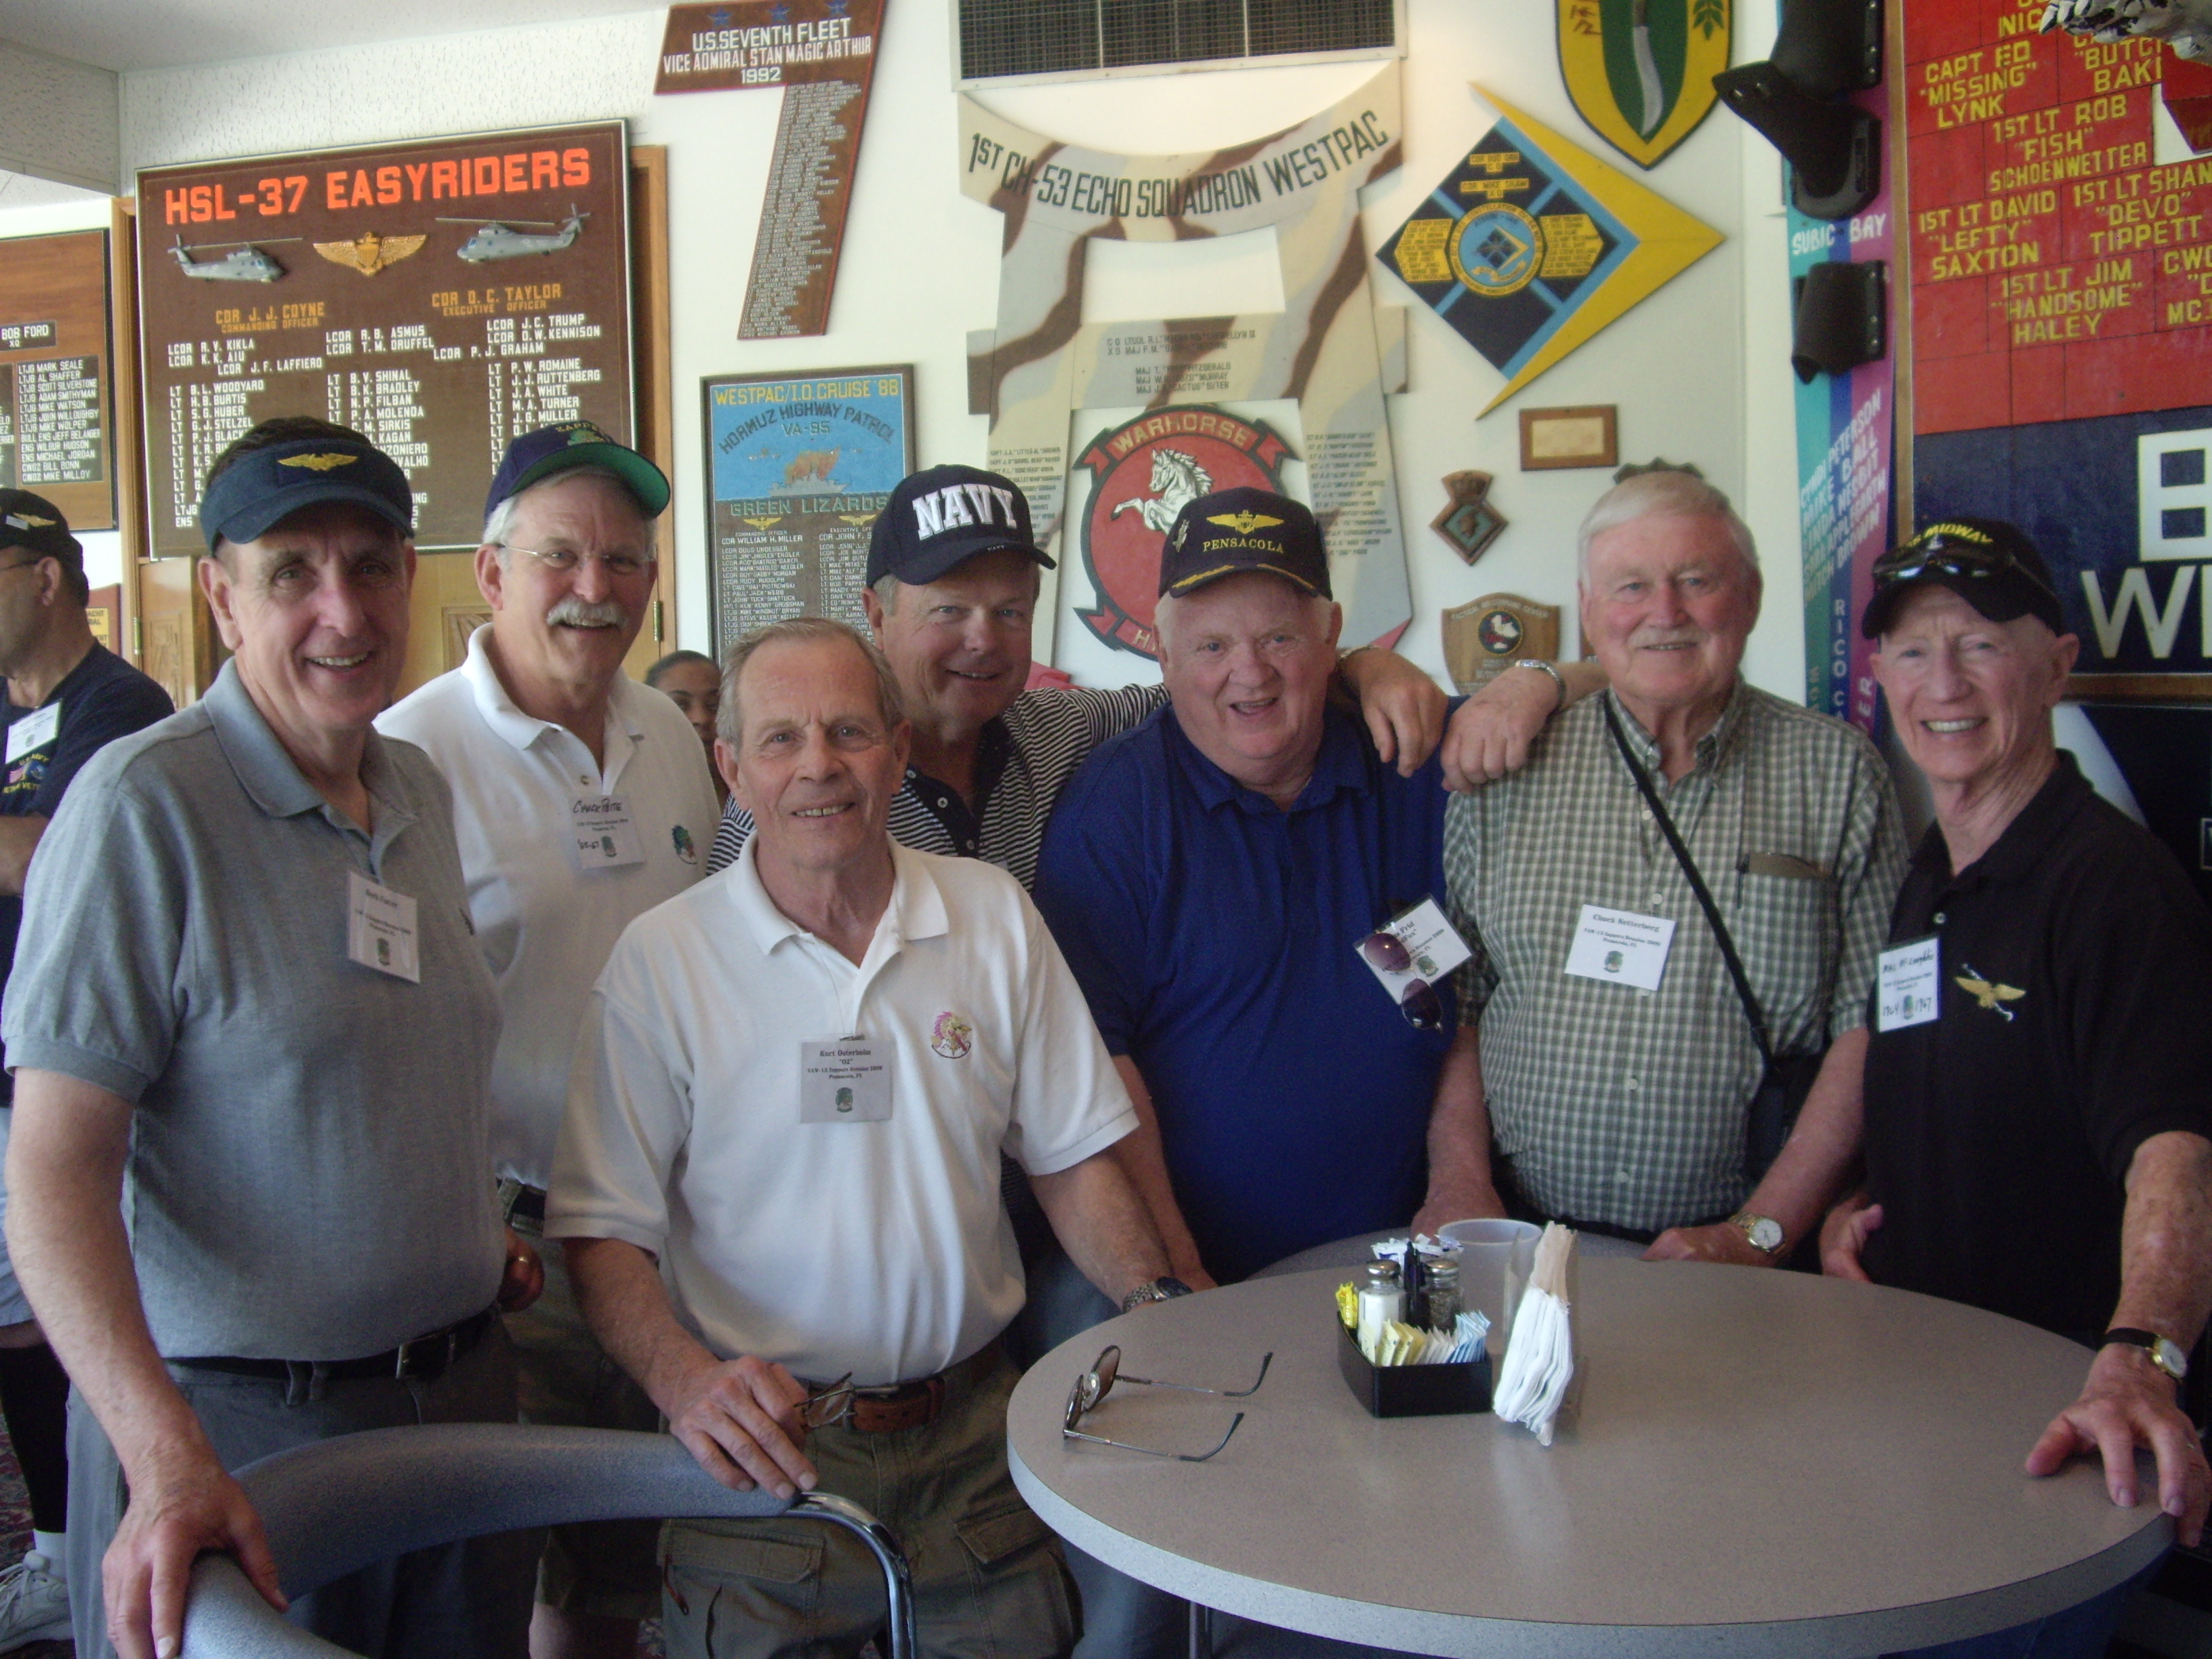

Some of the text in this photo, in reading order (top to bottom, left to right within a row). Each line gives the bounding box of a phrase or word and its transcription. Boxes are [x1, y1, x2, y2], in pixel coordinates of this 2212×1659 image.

[797, 17, 852, 42] FLEET
[663, 54, 691, 74] VICE
[693, 48, 747, 70] ADMIRAL
[750, 45, 782, 66] STAN
[825, 35, 872, 59] ARTHUR
[1925, 39, 2031, 84] CAPT ED
[741, 66, 781, 84] 1992
[1920, 62, 2036, 106] "MISSING"
[1938, 94, 2005, 129] LYNK
[1992, 94, 2127, 143] 1ST LT ROB
[2015, 127, 2094, 162] "FISH"
[968, 108, 1390, 218] 1ST CH-53 ECHO SQUADRON WESTPAC
[1989, 140, 2148, 191] SCHOENWETTER
[165, 147, 591, 226] HSL-37 EASYRIDERS
[2074, 179, 2107, 207] 1ST
[2115, 173, 2141, 199] LT
[1919, 190, 2056, 234] 1ST LT DAVID
[2095, 190, 2193, 226] "DEVO"
[1792, 213, 1886, 256] SUBIC BAY
[1929, 219, 2032, 253] "LEFTY"
[2089, 214, 2203, 254] TIPPETT
[1932, 241, 2040, 280] SAXTON
[2001, 258, 2133, 298] 1ST LT JIM
[432, 292, 460, 308] CDR
[504, 283, 562, 302] TAYLOR
[1992, 281, 2144, 321] "HANDSOME"
[216, 309, 242, 325] CDR
[282, 302, 325, 319] COYNE
[443, 299, 546, 317] EXECUTIVE OFFICER
[1, 325, 49, 340] BOB FORD
[221, 316, 319, 334] COMMANDING OFFICER
[325, 331, 351, 343] LCDR
[390, 325, 425, 339] ASMUS
[487, 319, 514, 331] LCDR
[548, 313, 586, 327] TRUMP
[2015, 312, 2102, 345] HALEY
[168, 343, 192, 355] LCDR
[226, 338, 255, 350] KIKLA
[326, 343, 352, 355] LCDR
[390, 337, 434, 350] DRUFFEL
[487, 331, 514, 344] LCDR
[549, 325, 600, 340] KENNISON
[169, 354, 193, 367] LCDR
[228, 350, 245, 363] AIU
[434, 347, 461, 360] LCDR
[500, 342, 544, 356] GRAHAM
[37, 362, 57, 373] MARK
[60, 360, 83, 371] SEALE
[38, 373, 47, 383] AL
[49, 371, 81, 382] SHAFFER
[218, 363, 242, 375] LCDR
[276, 356, 323, 371] LAFFIERO
[489, 363, 501, 375] LT
[538, 357, 581, 372] ROMAINE
[37, 382, 57, 392] SCOTT
[57, 378, 98, 390] SILVERSTONE
[169, 385, 181, 397] LT
[213, 379, 264, 392] WOODYARD
[489, 375, 501, 387] LT
[537, 369, 600, 384] RUTTENBERG
[817, 380, 869, 400] CRUISE
[39, 391, 57, 402] ADAM
[58, 388, 96, 401] SMITHYMAN
[718, 401, 896, 455] HORMUZ HIGHWAY PATROL
[1113, 413, 1248, 453] WARHORSE
[730, 495, 886, 517] GREEN LIZARDS
[912, 483, 1017, 541] NAVY
[737, 536, 766, 544] WILLIAM
[779, 535, 803, 544] MILLER
[1203, 537, 1284, 554] PENSACOLA
[1832, 598, 1847, 677] RICO
[1593, 914, 1616, 924] Chuck
